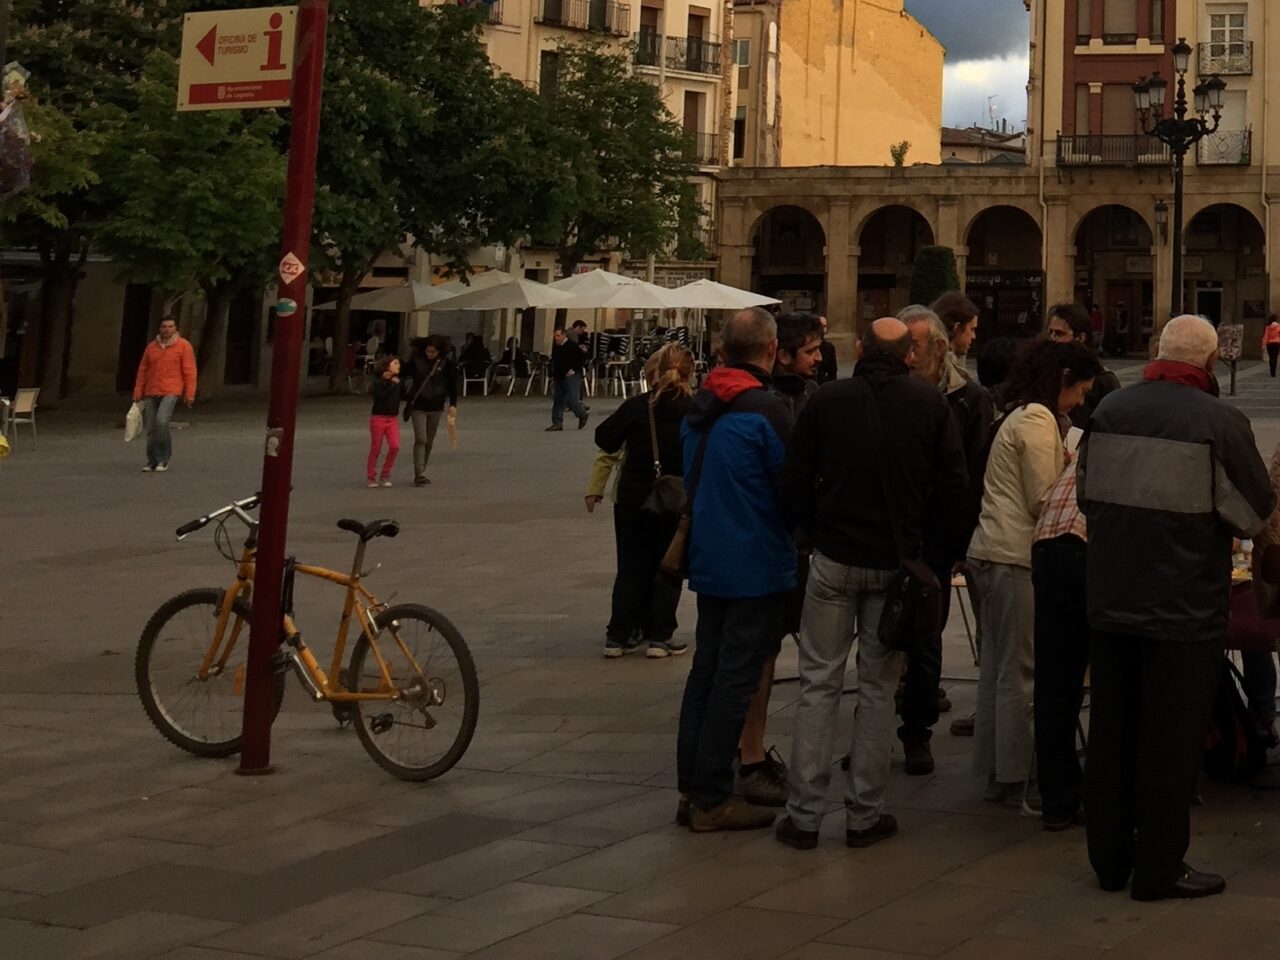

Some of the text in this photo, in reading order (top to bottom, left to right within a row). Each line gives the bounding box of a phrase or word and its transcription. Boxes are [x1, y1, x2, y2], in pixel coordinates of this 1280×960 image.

[218, 33, 257, 44] OFICINA DE
[217, 45, 248, 55] TURISMO
